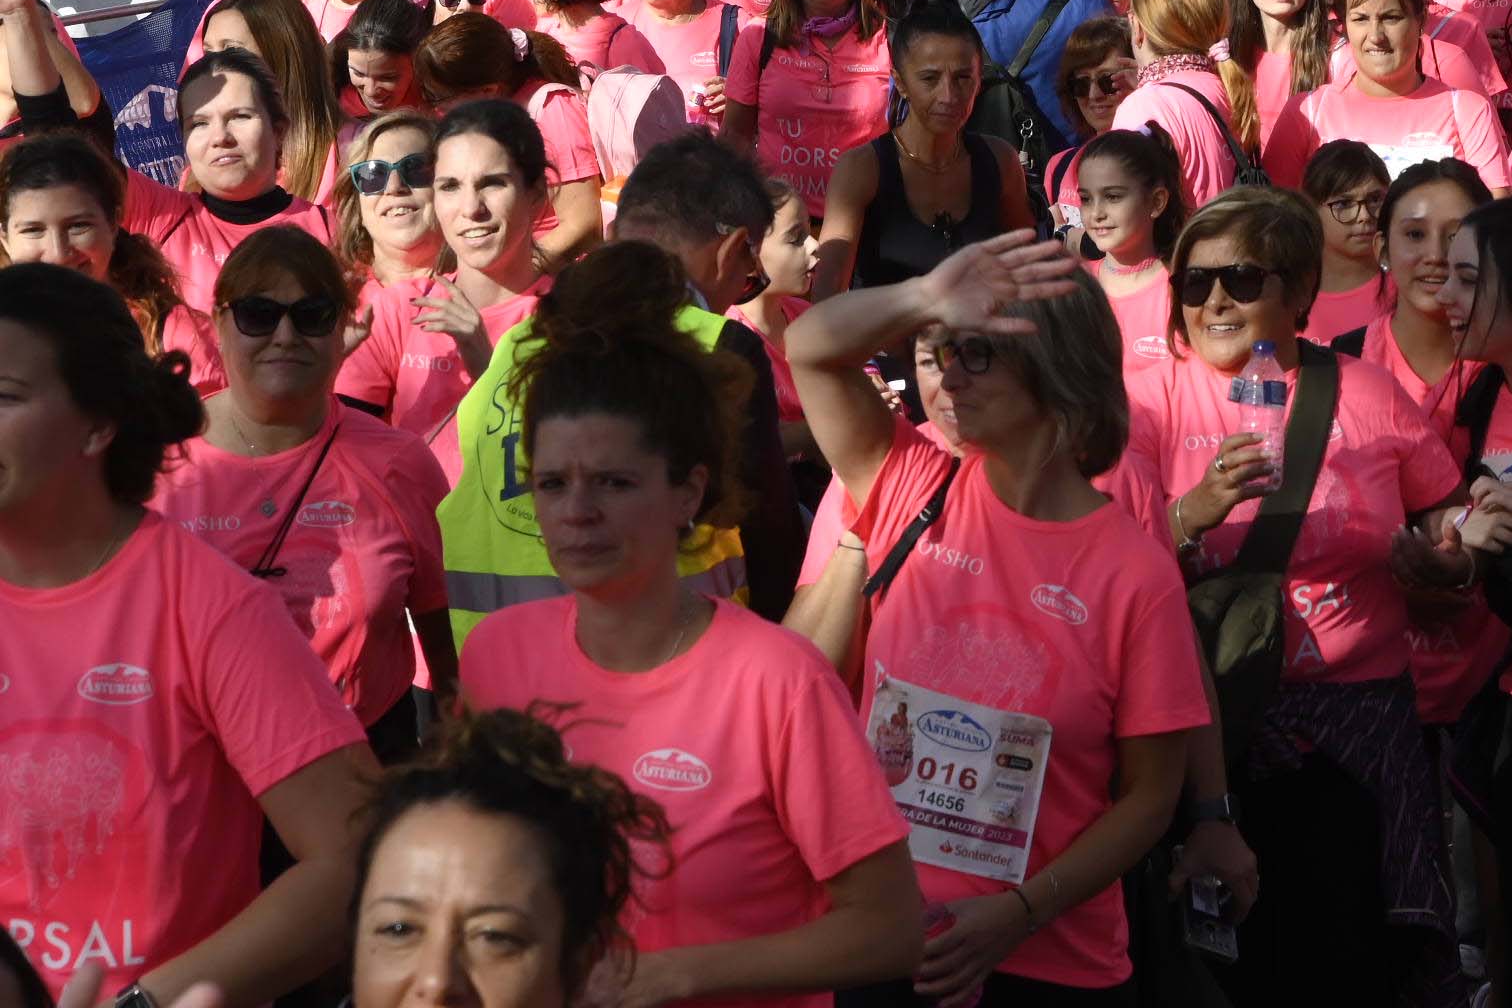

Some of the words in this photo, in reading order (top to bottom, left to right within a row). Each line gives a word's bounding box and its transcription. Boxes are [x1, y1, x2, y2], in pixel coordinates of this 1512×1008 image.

[916, 538, 985, 576] OYSHO
[917, 757, 978, 791] 016
[918, 789, 966, 813] 14656
[932, 814, 947, 826] LA
[948, 818, 985, 836] MUJER
[954, 844, 1013, 867] Santander
